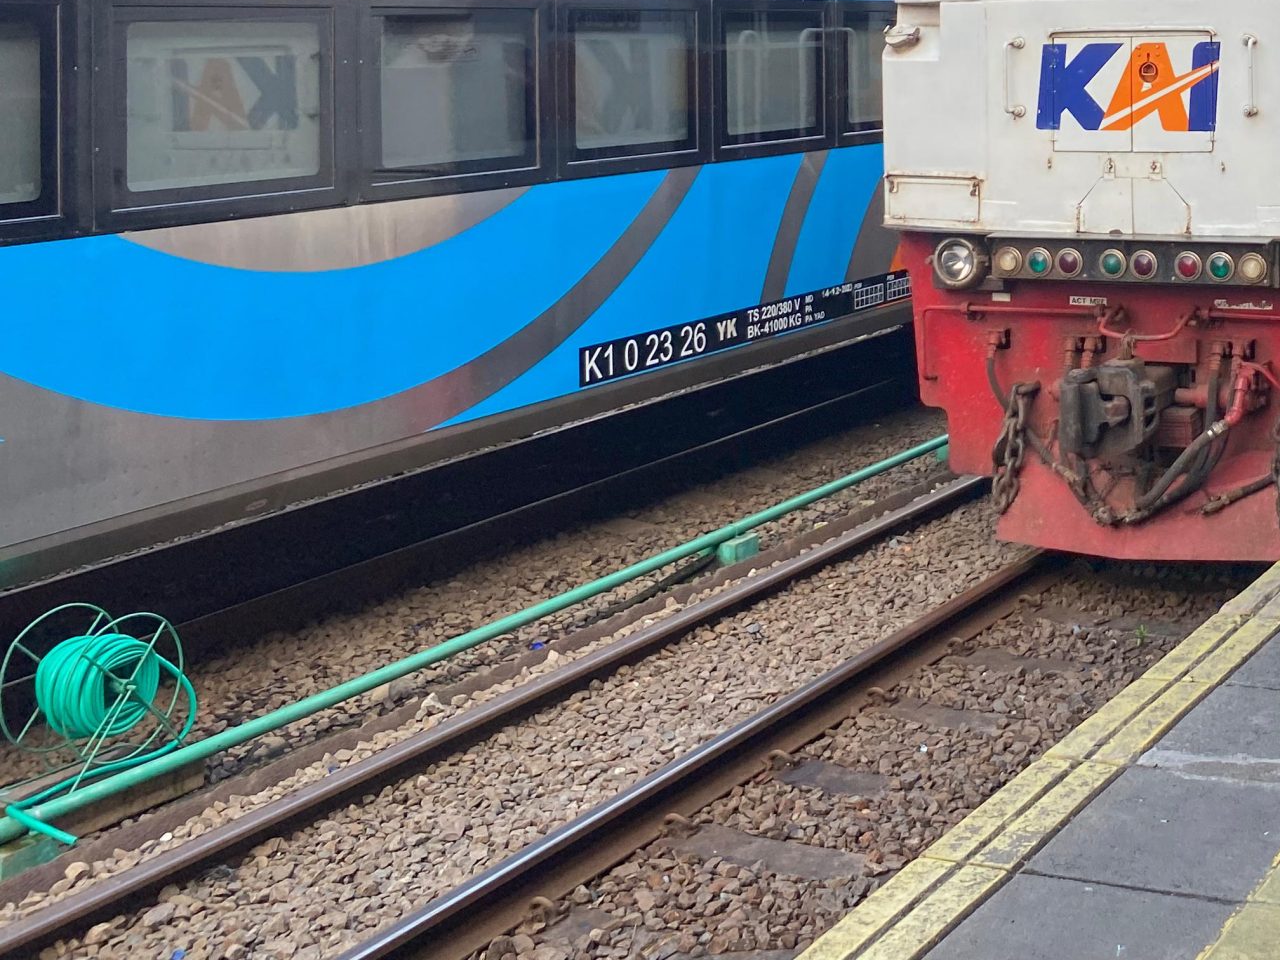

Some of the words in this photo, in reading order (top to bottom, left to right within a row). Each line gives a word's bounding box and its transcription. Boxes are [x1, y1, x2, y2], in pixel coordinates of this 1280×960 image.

[1036, 41, 1221, 132] KAI
[747, 309, 759, 323] TS
[762, 301, 792, 318] 220/380
[794, 298, 801, 310] V
[716, 317, 737, 341] YK
[747, 318, 788, 339] BK-41000
[790, 313, 801, 326] KG
[585, 345, 614, 383] K1
[646, 329, 673, 366] 23
[680, 322, 706, 358] 26
